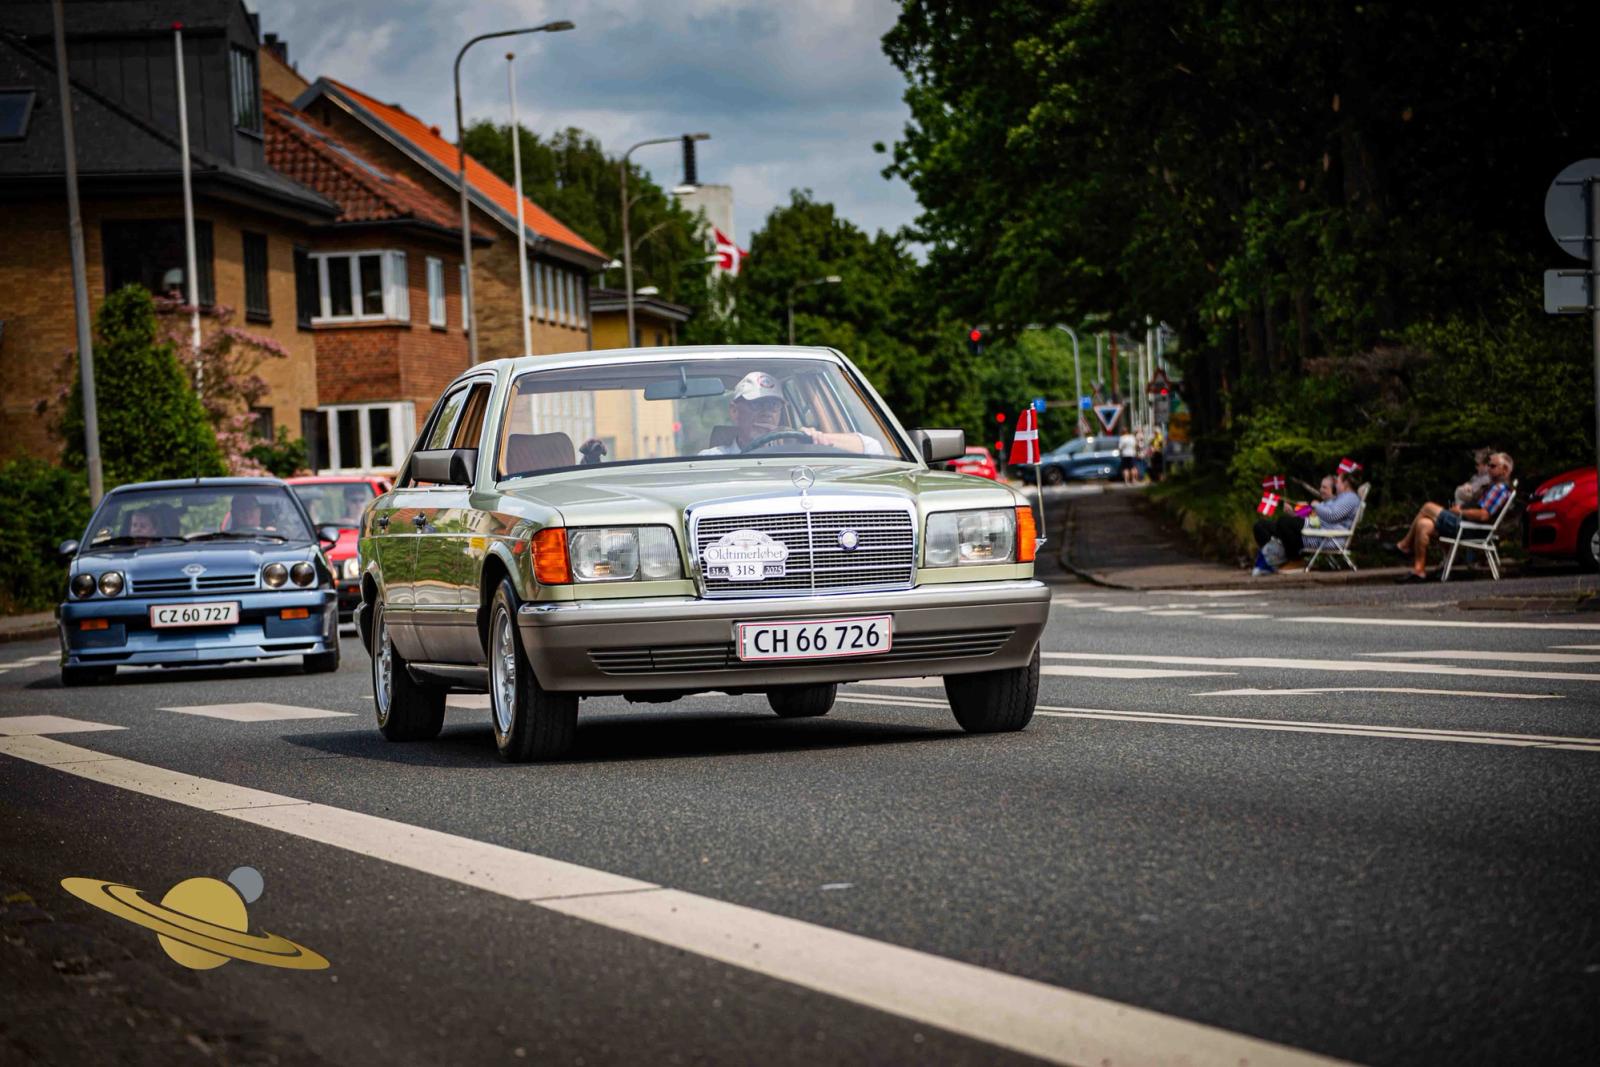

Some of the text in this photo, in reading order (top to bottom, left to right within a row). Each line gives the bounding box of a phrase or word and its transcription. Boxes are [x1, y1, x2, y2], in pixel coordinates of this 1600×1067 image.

[737, 565, 756, 576] 318
[765, 565, 783, 575] 2025
[158, 607, 231, 623] CZ 60 727
[754, 623, 880, 653] CH 66 726
